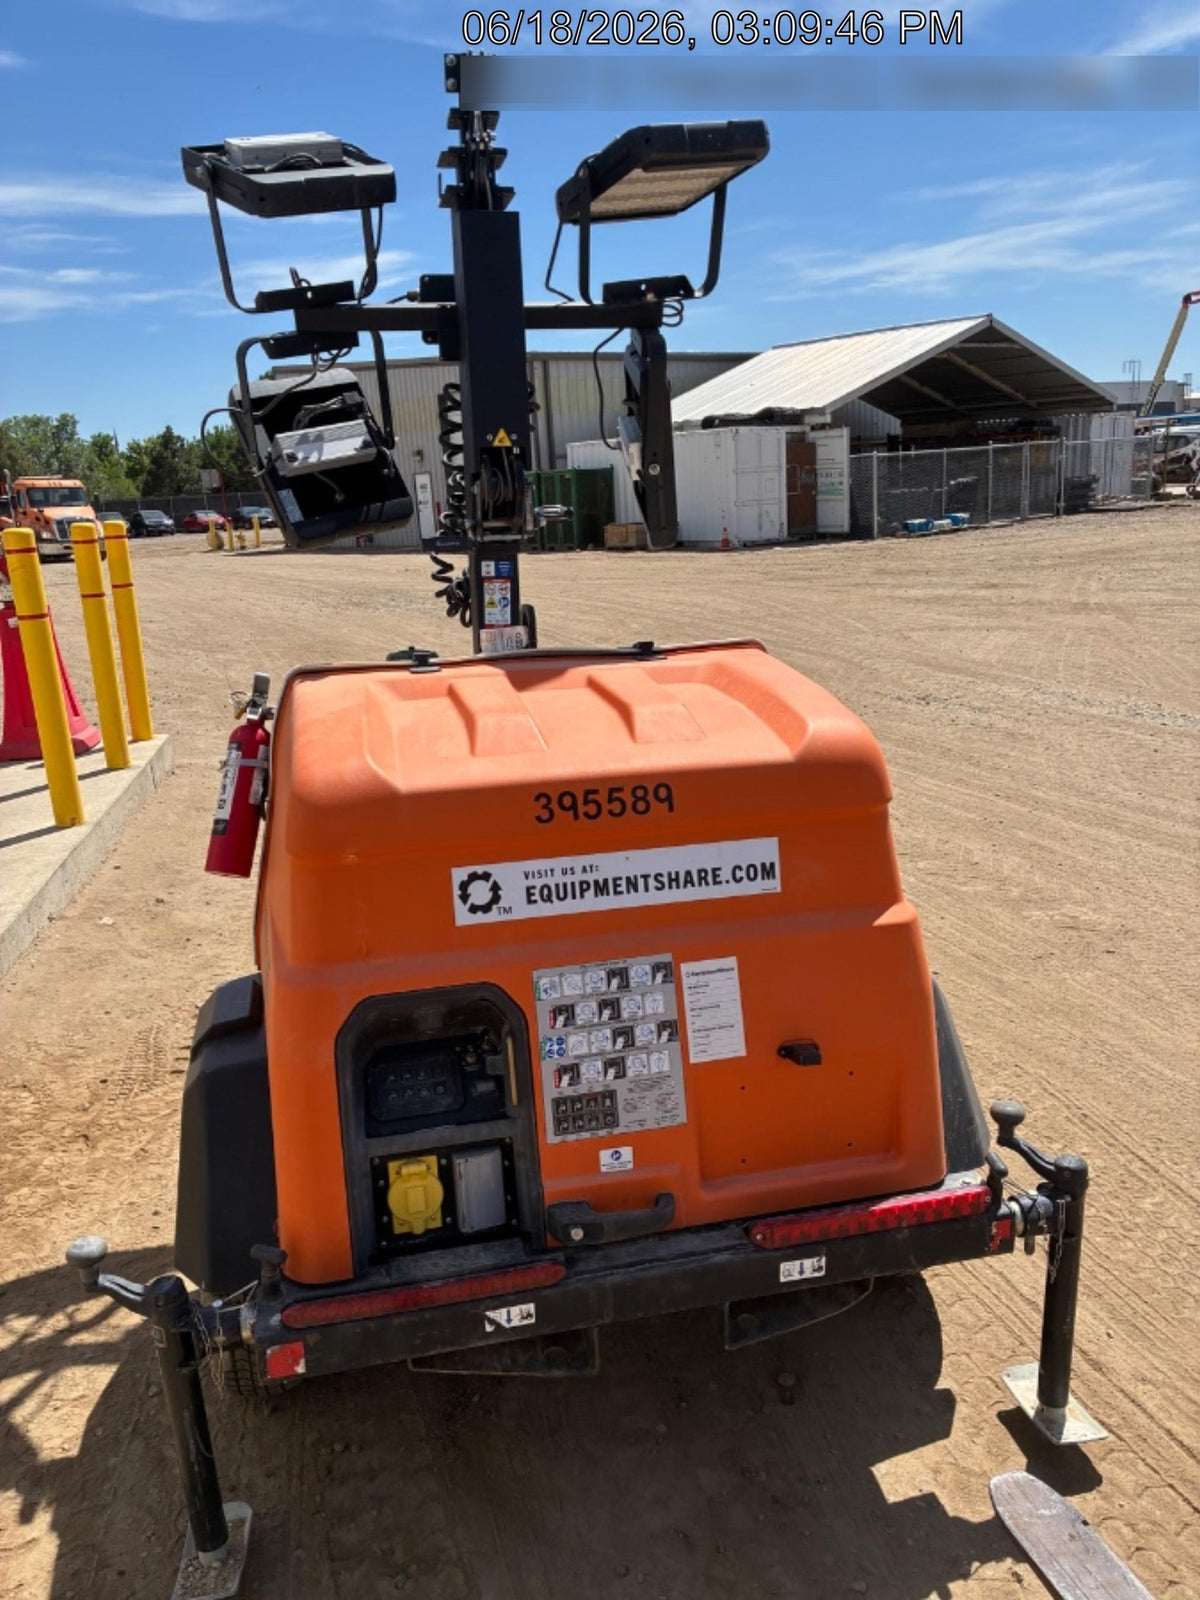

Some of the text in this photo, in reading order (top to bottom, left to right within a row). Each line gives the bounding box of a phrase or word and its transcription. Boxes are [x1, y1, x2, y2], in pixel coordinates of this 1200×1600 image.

[533, 783, 675, 823] 395589
[523, 864, 600, 881] VISIT US AT:
[525, 861, 777, 906] EQUIPMENTSHARE.COM
[497, 906, 513, 916] TM
